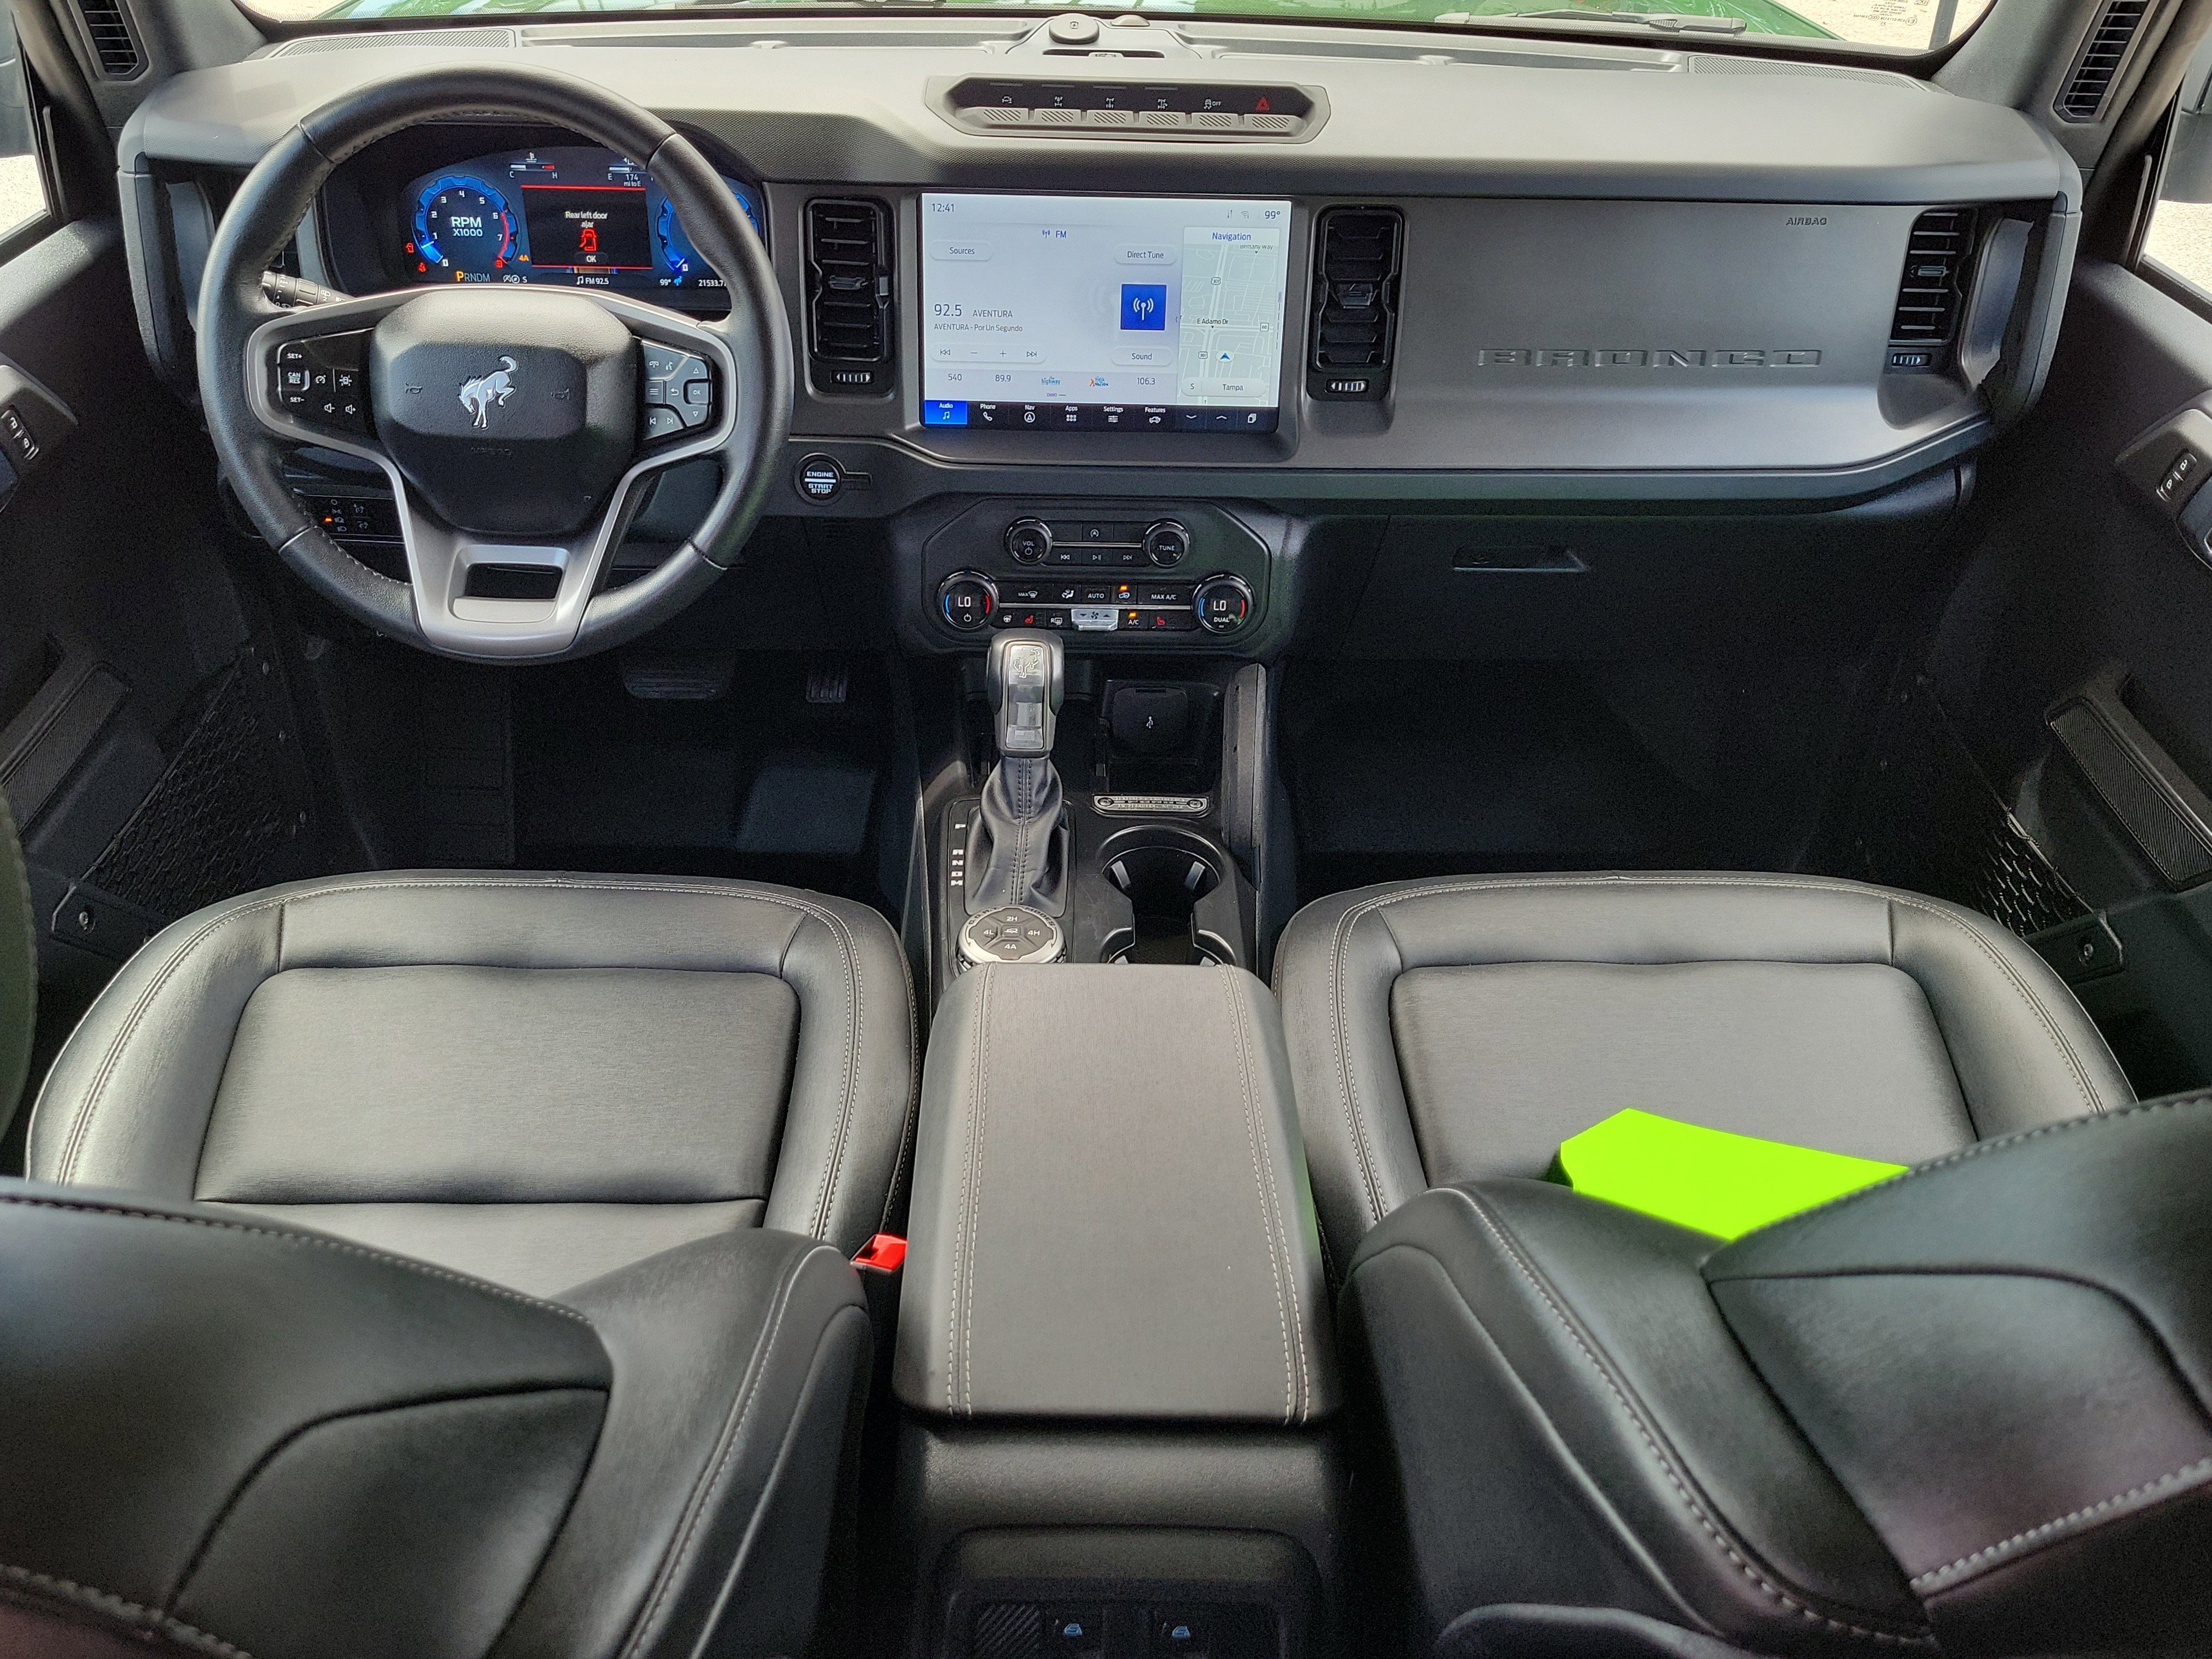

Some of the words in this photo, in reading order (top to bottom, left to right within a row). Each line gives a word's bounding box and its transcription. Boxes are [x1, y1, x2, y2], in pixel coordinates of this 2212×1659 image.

[608, 172, 613, 180] E
[932, 203, 955, 212] 12:41
[580, 211, 592, 219] left
[451, 216, 482, 228] RPM
[581, 221, 594, 229] ajar
[1786, 217, 1827, 226] AIRBAG
[453, 228, 483, 237] X1000
[1056, 230, 1066, 239] FM
[1212, 232, 1251, 242] Navigation
[949, 247, 975, 255] Sources
[1127, 250, 1146, 259] Direct
[1147, 251, 1164, 259] Tune
[442, 259, 449, 267] 0
[934, 303, 962, 317] 92.5
[973, 309, 1013, 318] AVENTURA
[1131, 352, 1153, 360] Sound
[1477, 348, 1823, 368] BRONCO
[948, 373, 962, 381] 540
[995, 374, 1011, 383] 89.9
[1137, 377, 1155, 386] 106.3
[958, 596, 971, 607] LO
[1213, 600, 1227, 611] LO
[1025, 907, 1056, 927] MODES
